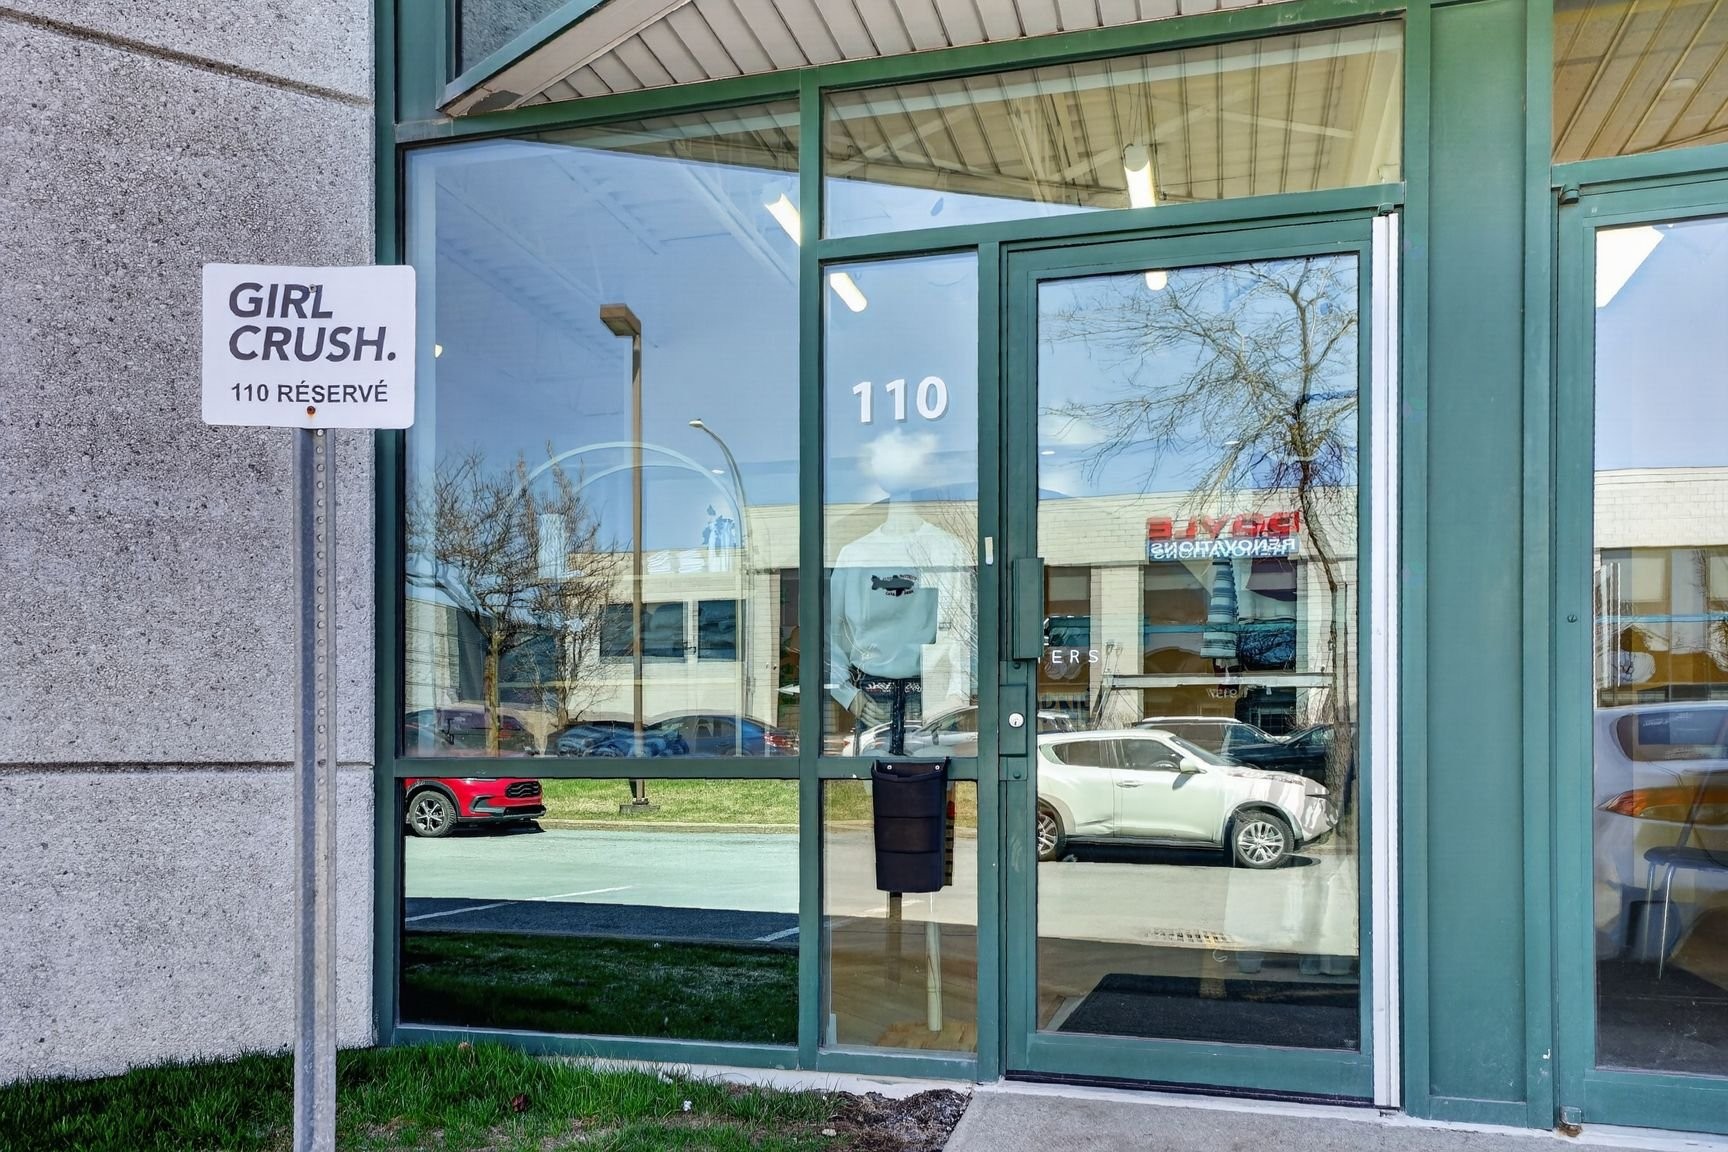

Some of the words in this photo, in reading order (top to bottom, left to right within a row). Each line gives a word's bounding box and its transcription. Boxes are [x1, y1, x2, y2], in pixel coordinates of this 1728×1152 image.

[229, 282, 334, 319] GIRL
[229, 325, 397, 362] CRUSH.
[231, 382, 269, 402] 110
[277, 380, 388, 403] RÉSERVÉ
[852, 376, 949, 423] 110
